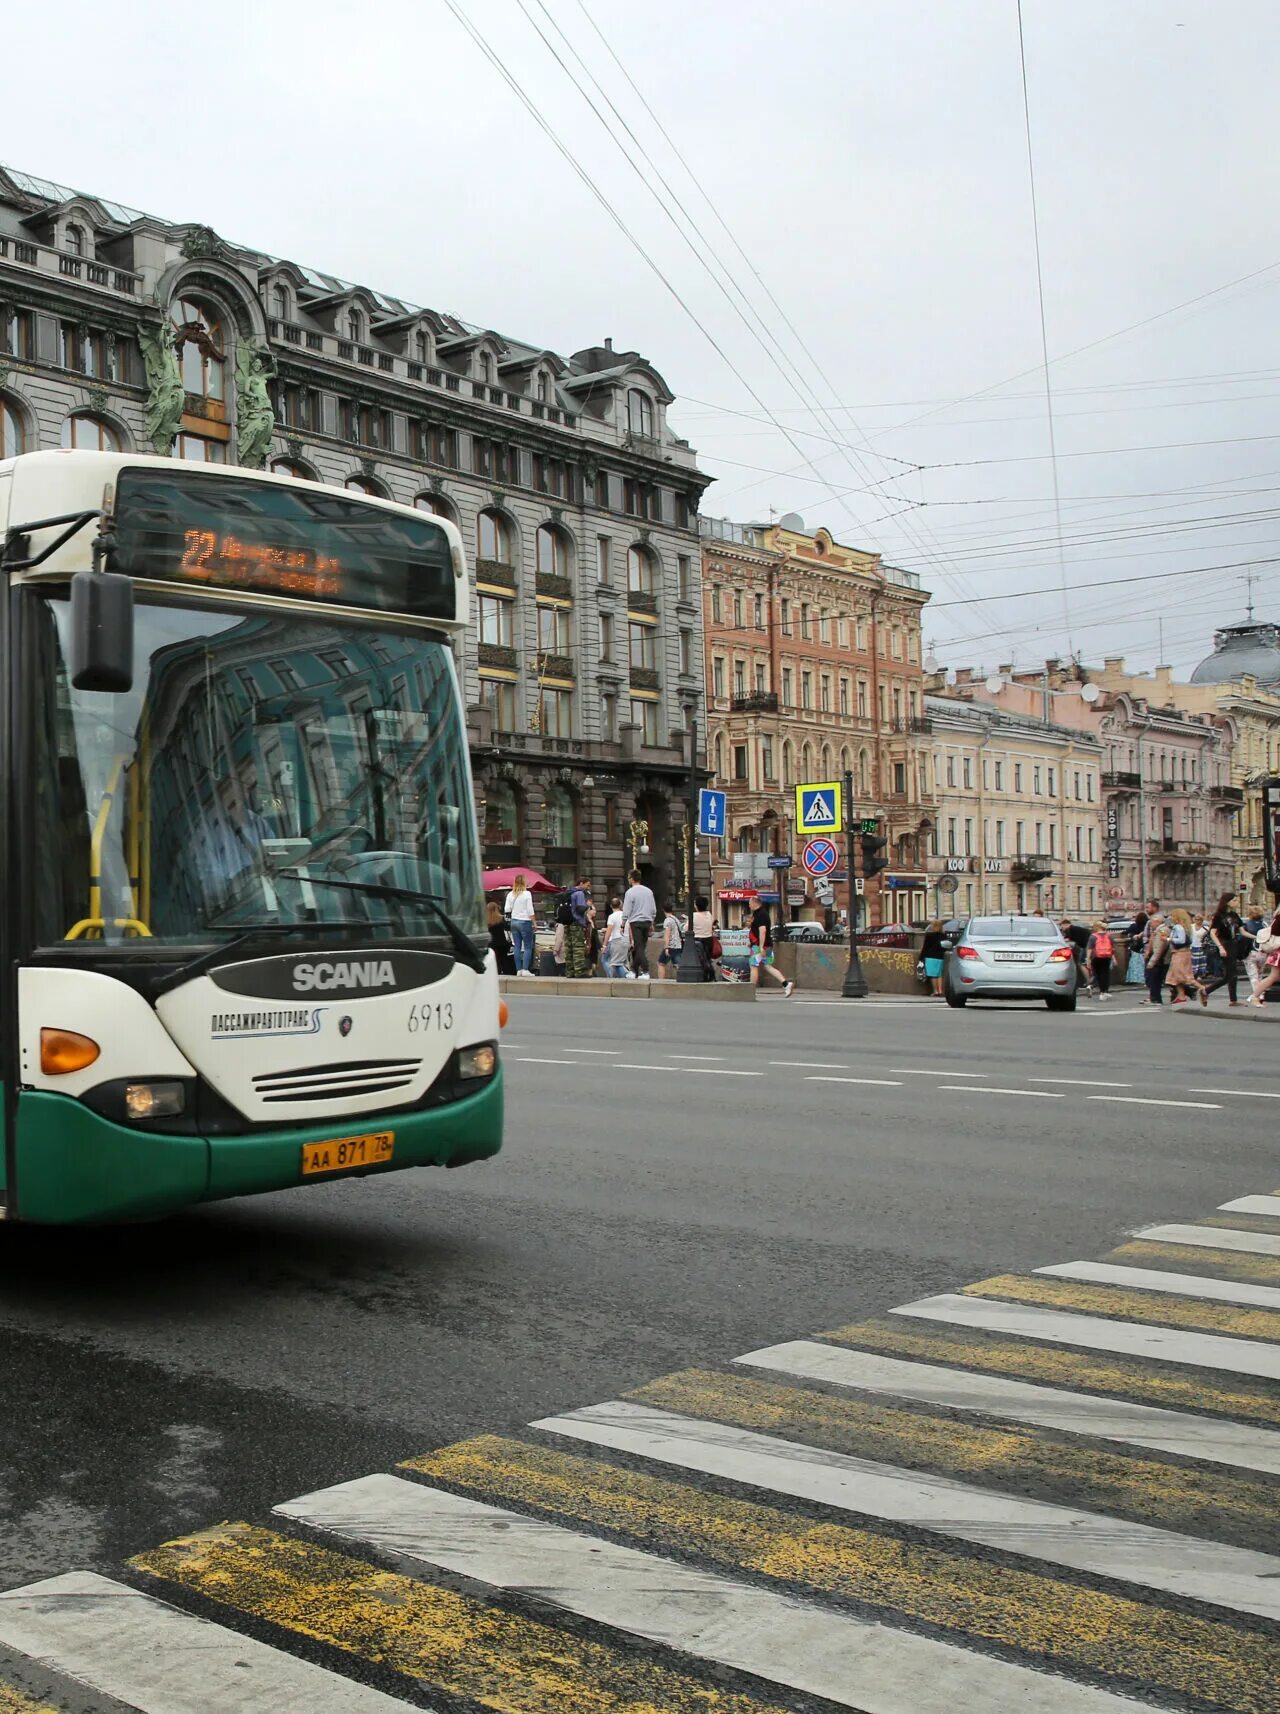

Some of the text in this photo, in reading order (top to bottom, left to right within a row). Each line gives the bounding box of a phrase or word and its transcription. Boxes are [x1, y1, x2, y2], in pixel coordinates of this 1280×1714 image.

[181, 529, 215, 568] 22
[1108, 809, 1117, 878] КОФЕ ХАУЗ
[293, 960, 397, 992] SCANIA
[211, 1009, 308, 1032] ПАССАЖИРАВТОТРАНС
[407, 1002, 454, 1033] 6913
[311, 1135, 389, 1169] АА 871 78
